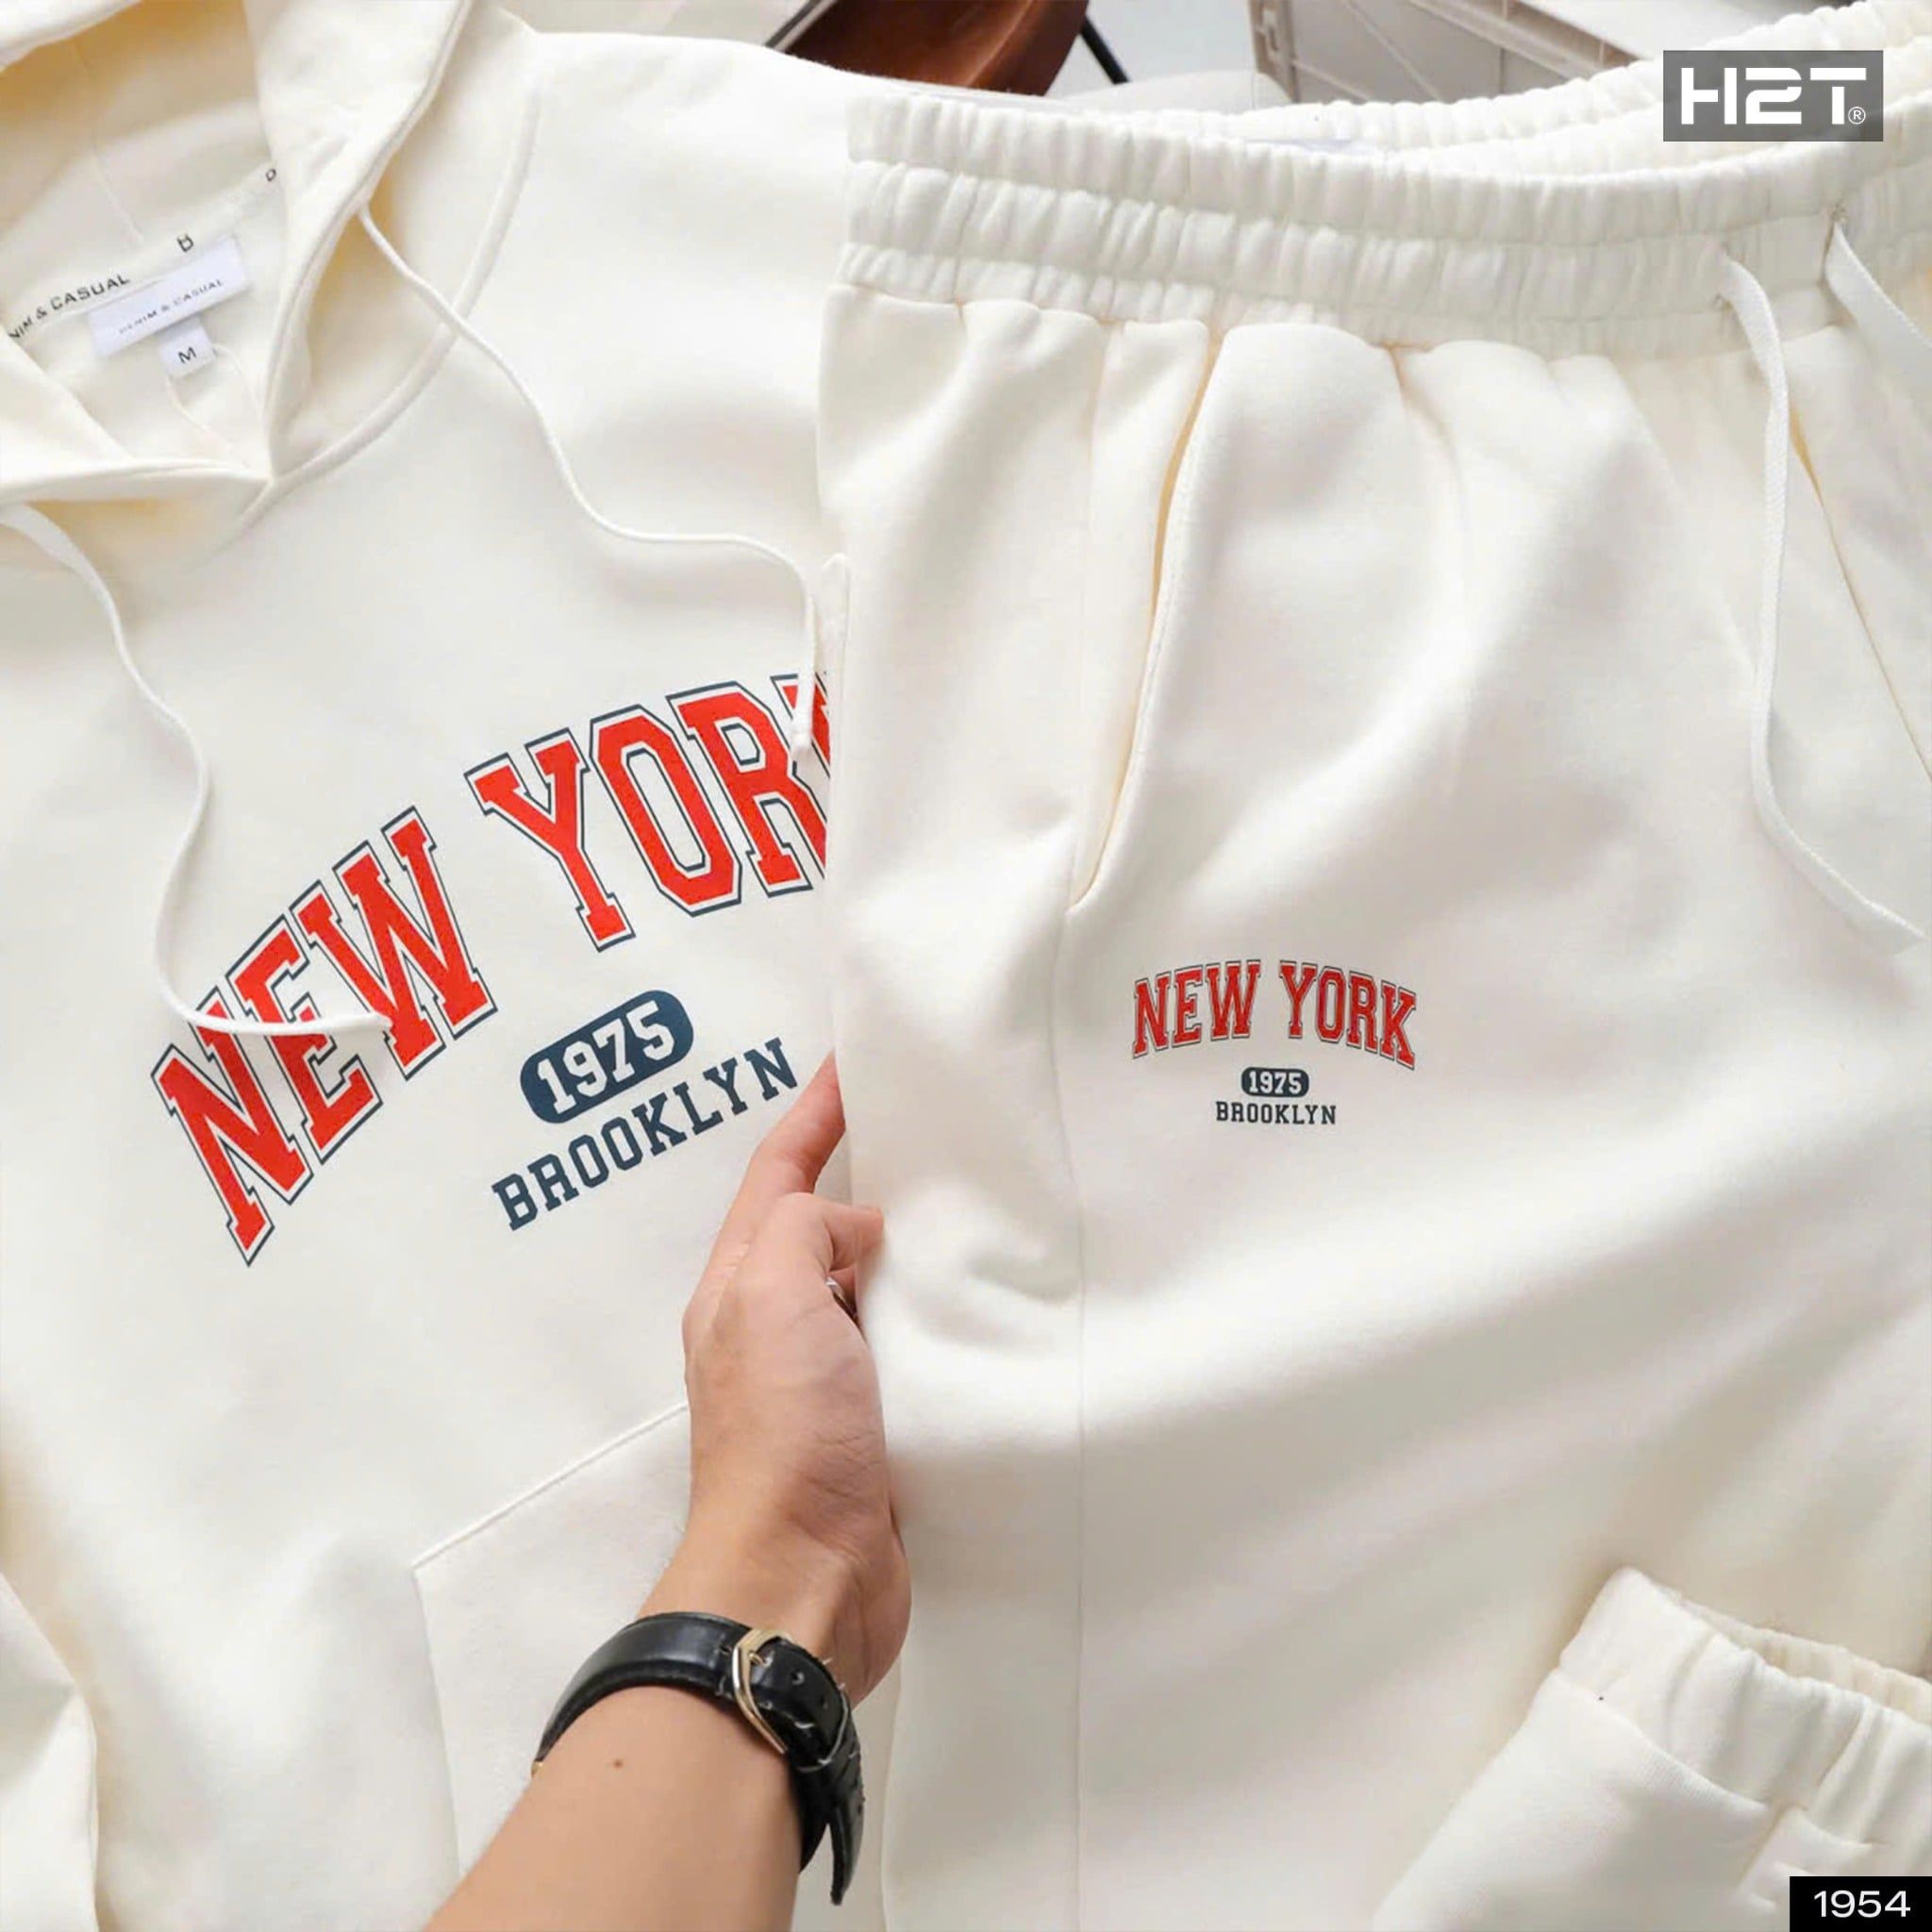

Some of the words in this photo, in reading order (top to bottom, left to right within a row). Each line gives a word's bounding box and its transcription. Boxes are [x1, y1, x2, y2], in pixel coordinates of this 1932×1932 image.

[50, 273, 131, 311] CASUAL
[177, 345, 198, 364] M
[151, 805, 498, 1266] NEW
[1133, 958, 1261, 1059] NEW
[1280, 958, 1417, 1071] YORK
[536, 999, 675, 1115] 1975
[1247, 1070, 1303, 1095] 1975
[491, 1037, 799, 1231] BROOKLYN
[1215, 1100, 1338, 1125] BROOKLYN
